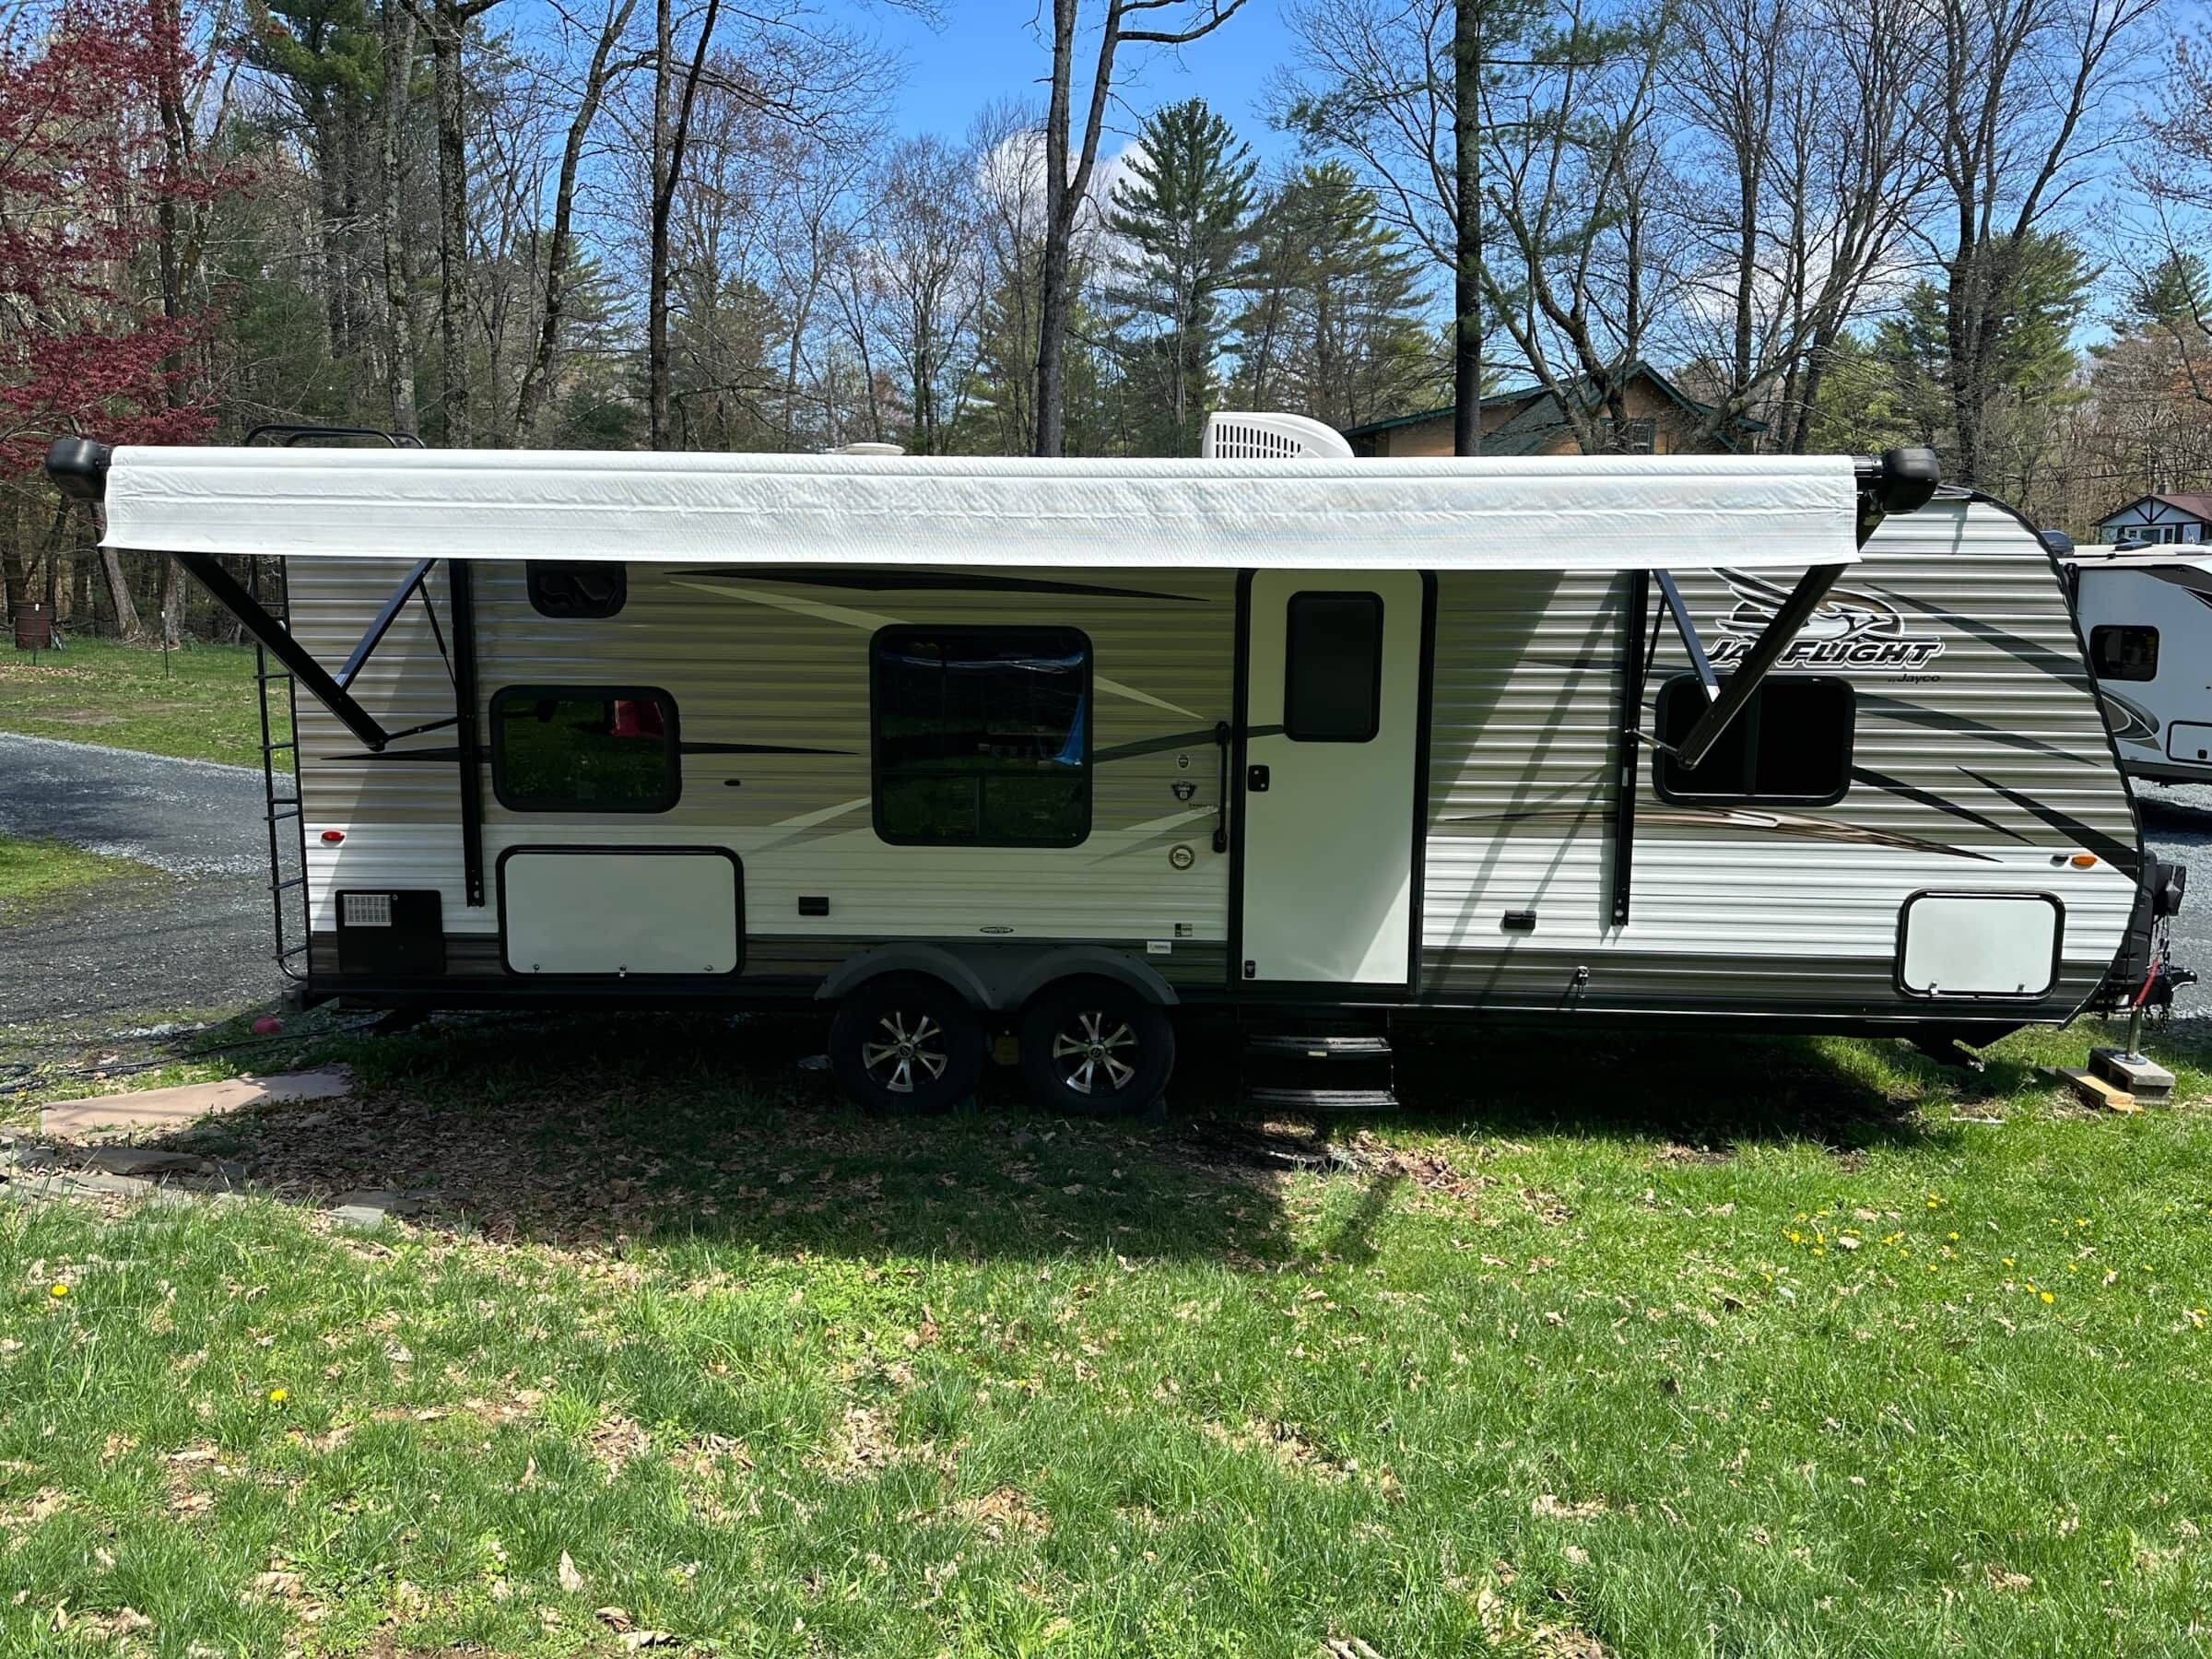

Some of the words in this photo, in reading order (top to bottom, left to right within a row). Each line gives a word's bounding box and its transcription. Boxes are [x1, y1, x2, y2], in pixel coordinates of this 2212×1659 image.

[1702, 638, 1759, 665] JA
[1779, 641, 1943, 666] FLIGHT
[1897, 673, 1940, 684] Jayco
